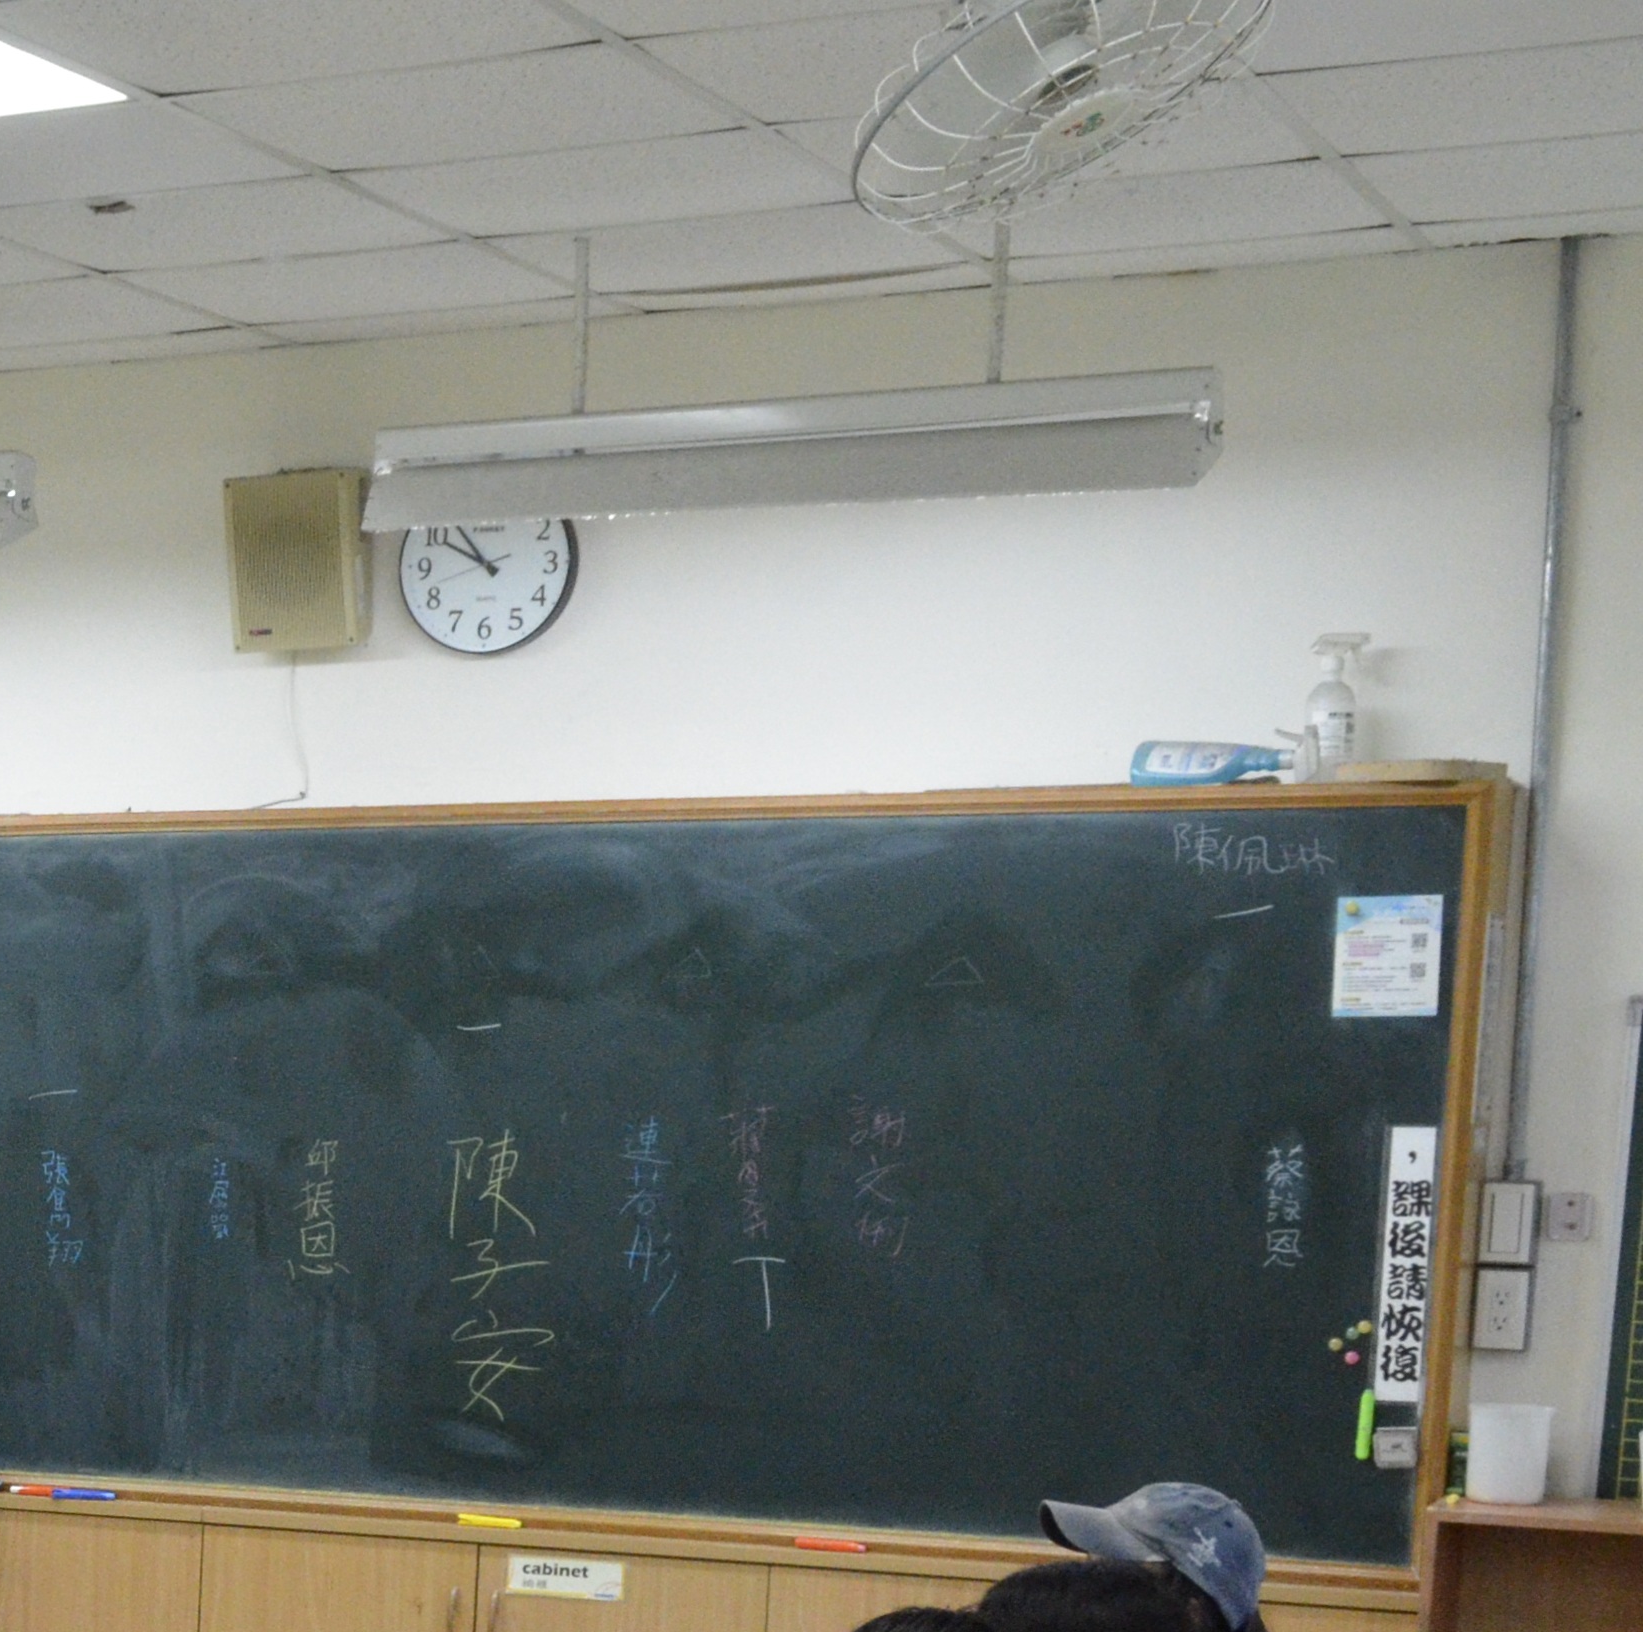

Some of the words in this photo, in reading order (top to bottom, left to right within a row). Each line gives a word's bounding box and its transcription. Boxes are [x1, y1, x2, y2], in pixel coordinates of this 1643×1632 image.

[536, 519, 551, 541] 2
[418, 557, 433, 581] 9
[543, 551, 559, 574] 3
[426, 586, 441, 610] 8
[531, 584, 547, 607] 4
[448, 610, 464, 633] 7
[477, 616, 492, 640] 6
[508, 608, 524, 631] 5
[287, 1138, 351, 1280] 邱振恩
[447, 1128, 556, 1422] 陳子安
[522, 1562, 590, 1579] cabinet
